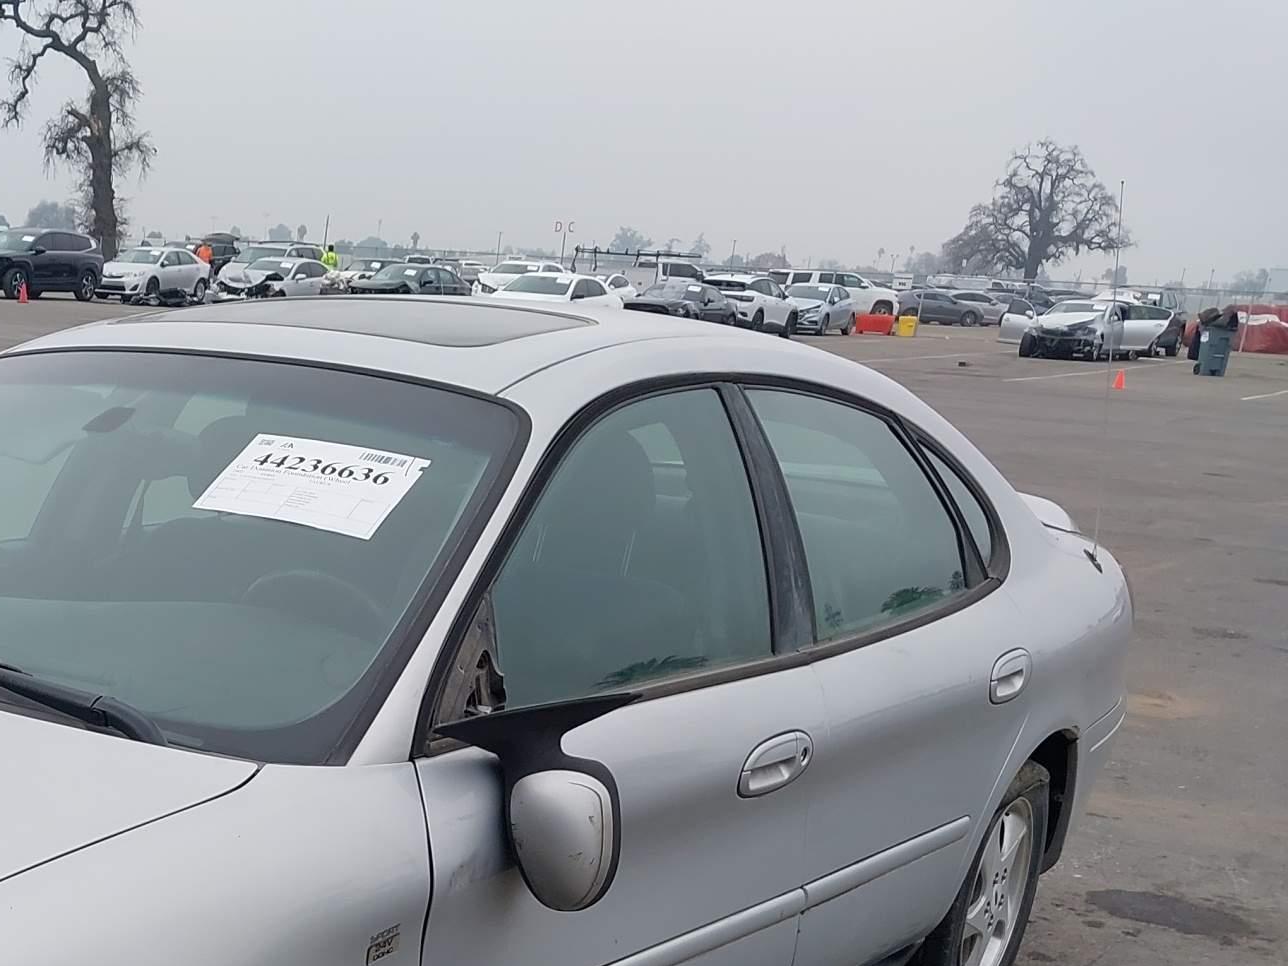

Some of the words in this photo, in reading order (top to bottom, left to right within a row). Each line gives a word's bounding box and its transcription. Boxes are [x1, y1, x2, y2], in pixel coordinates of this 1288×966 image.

[555, 221, 562, 232] D
[568, 221, 575, 232] C
[253, 452, 395, 486] 44236636
